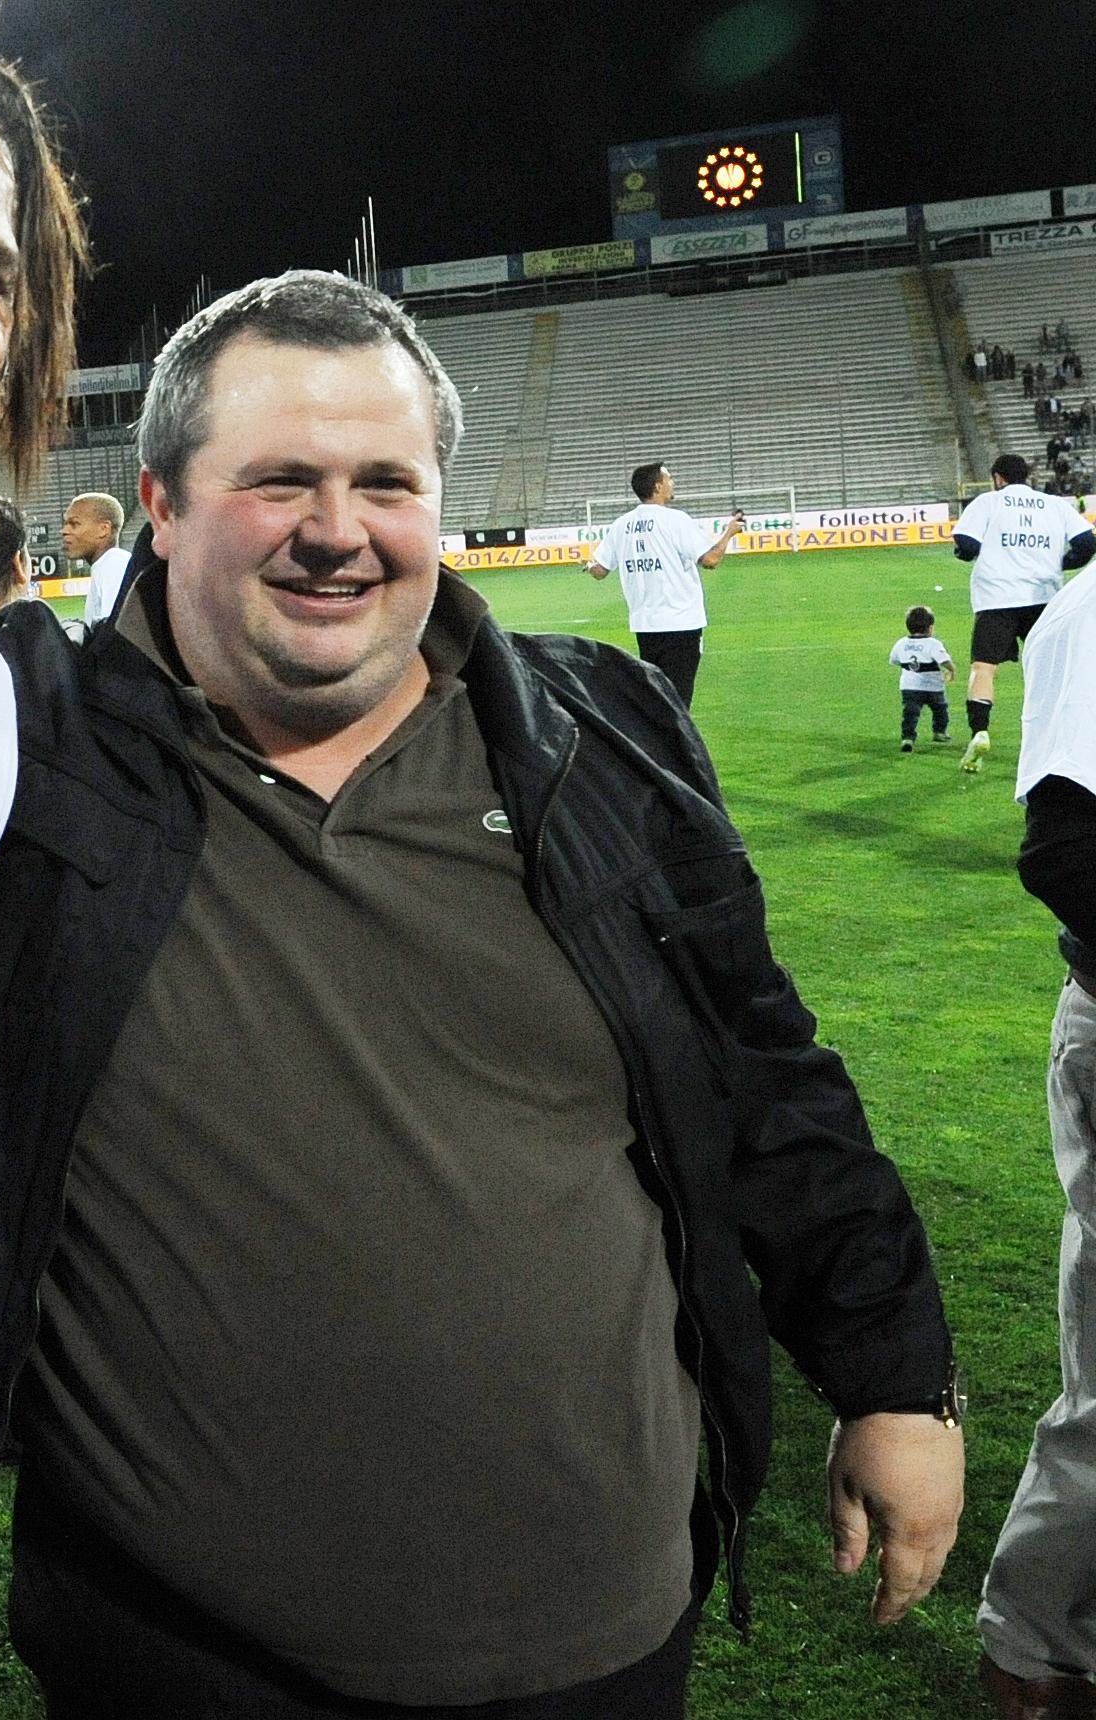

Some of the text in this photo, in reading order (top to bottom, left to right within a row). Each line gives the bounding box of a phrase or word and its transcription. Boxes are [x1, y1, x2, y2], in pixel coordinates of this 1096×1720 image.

[994, 225, 1083, 245] TREZZA
[1003, 495, 1046, 510] SIAMO
[624, 519, 655, 535] SIAMO
[819, 508, 928, 528] folletto.it
[1019, 514, 1033, 528] IN
[732, 527, 910, 551] LIFICAZIONE
[1000, 532, 1051, 550] EUROPA
[453, 546, 582, 568] 2014/2015
